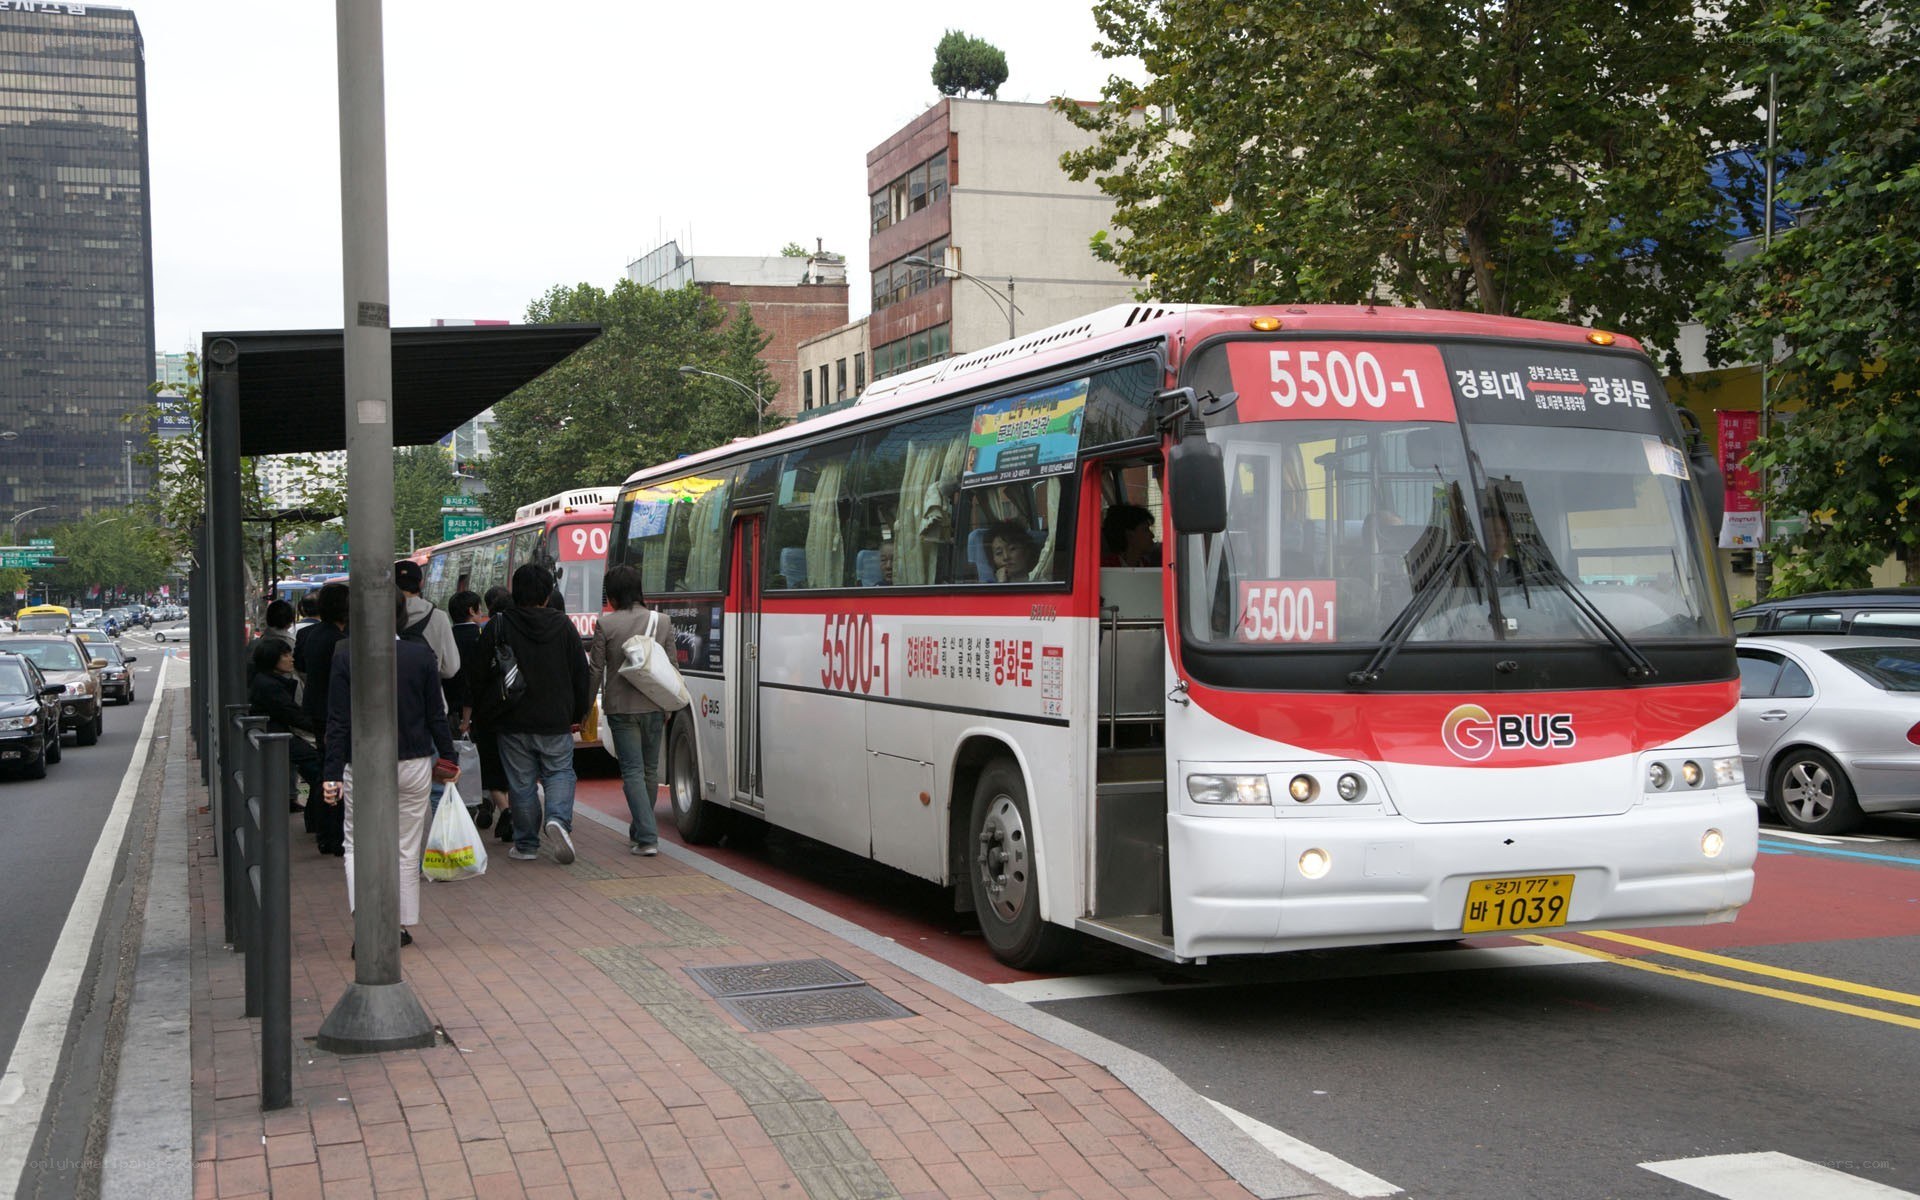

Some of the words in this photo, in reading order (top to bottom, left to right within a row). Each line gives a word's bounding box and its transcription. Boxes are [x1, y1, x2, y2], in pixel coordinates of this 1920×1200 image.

[1269, 350, 1425, 409] 5500-1
[1456, 370, 1525, 400] 경희대
[1528, 366, 1580, 381] 경부고속도로
[1588, 377, 1651, 410] 광화문
[571, 528, 611, 555] 90
[1244, 587, 1334, 641] 5500-1
[821, 611, 890, 697] 5500-1
[907, 635, 939, 679] 경희대학교
[993, 639, 1034, 687] 광화문
[1495, 881, 1521, 895] 경기
[1526, 879, 1549, 894] 77
[1469, 900, 1488, 922] 바
[1494, 895, 1564, 926] 1039
